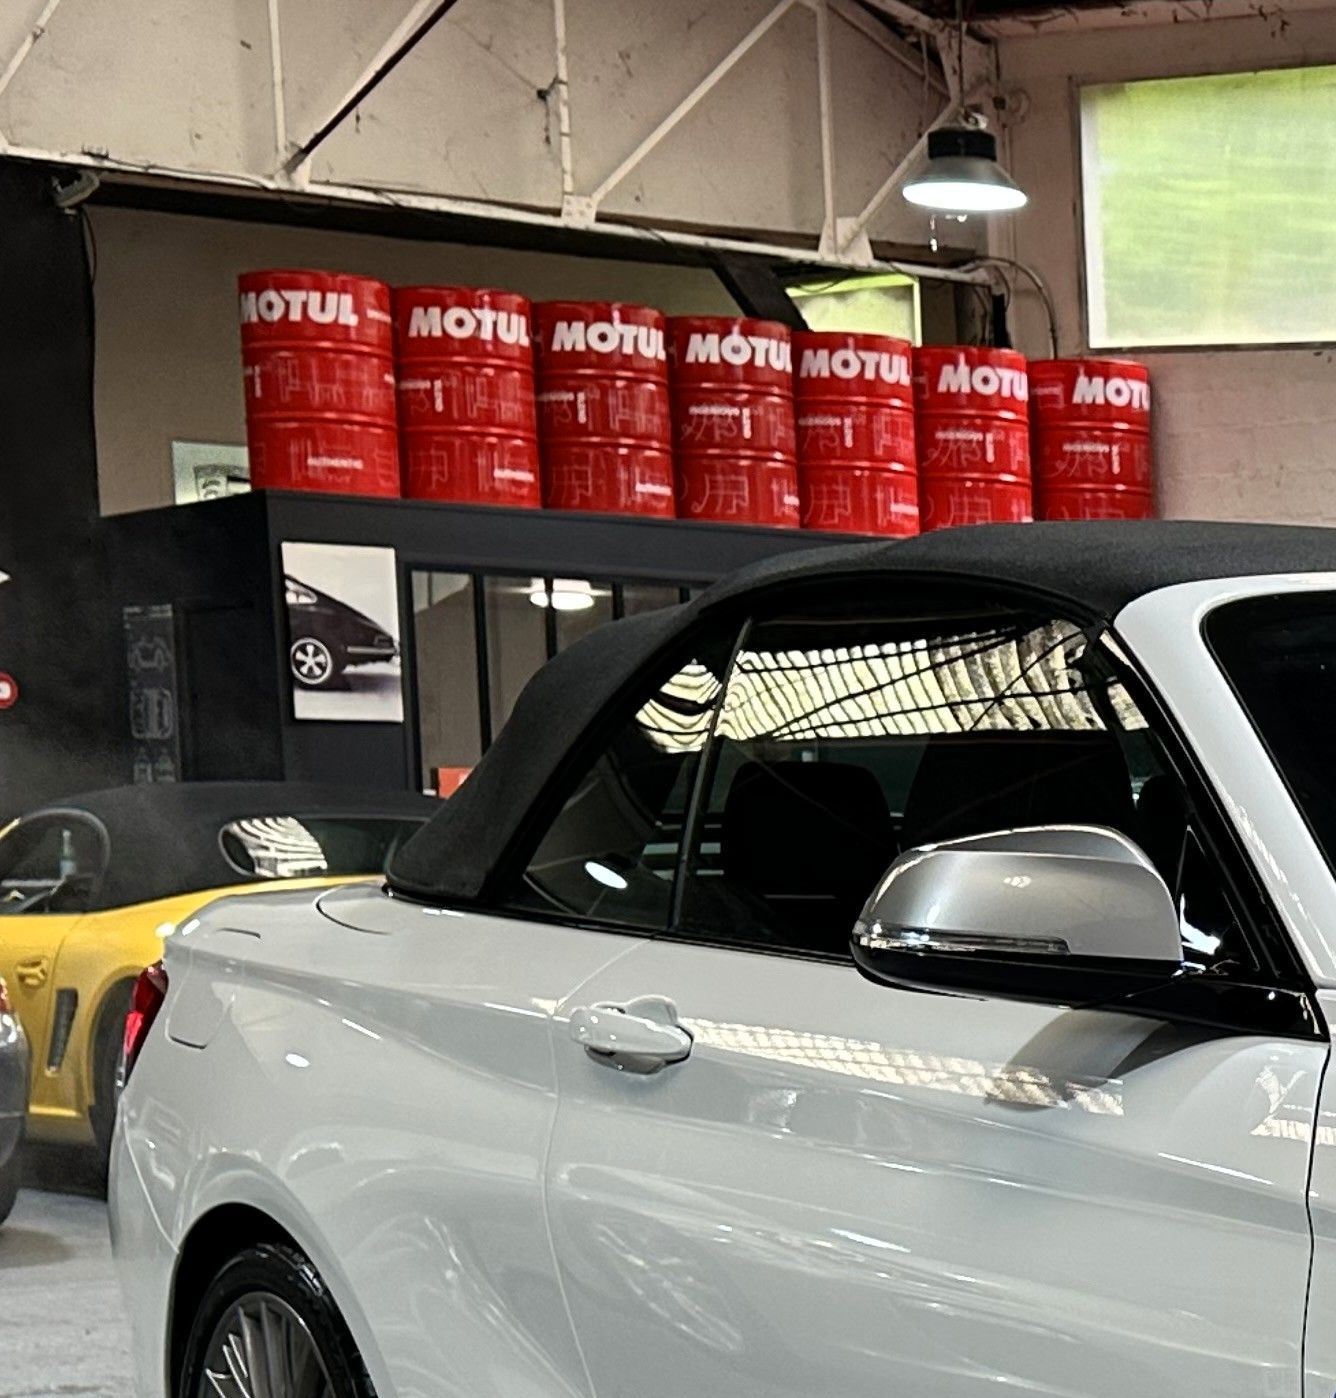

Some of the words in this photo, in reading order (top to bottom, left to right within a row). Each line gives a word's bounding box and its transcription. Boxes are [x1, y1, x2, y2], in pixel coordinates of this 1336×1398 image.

[240, 289, 358, 326] MOTUL
[408, 306, 530, 347] MOTUL
[551, 321, 666, 360] MOTUL
[799, 348, 910, 387] MOTUL
[937, 364, 1028, 402] MOTU
